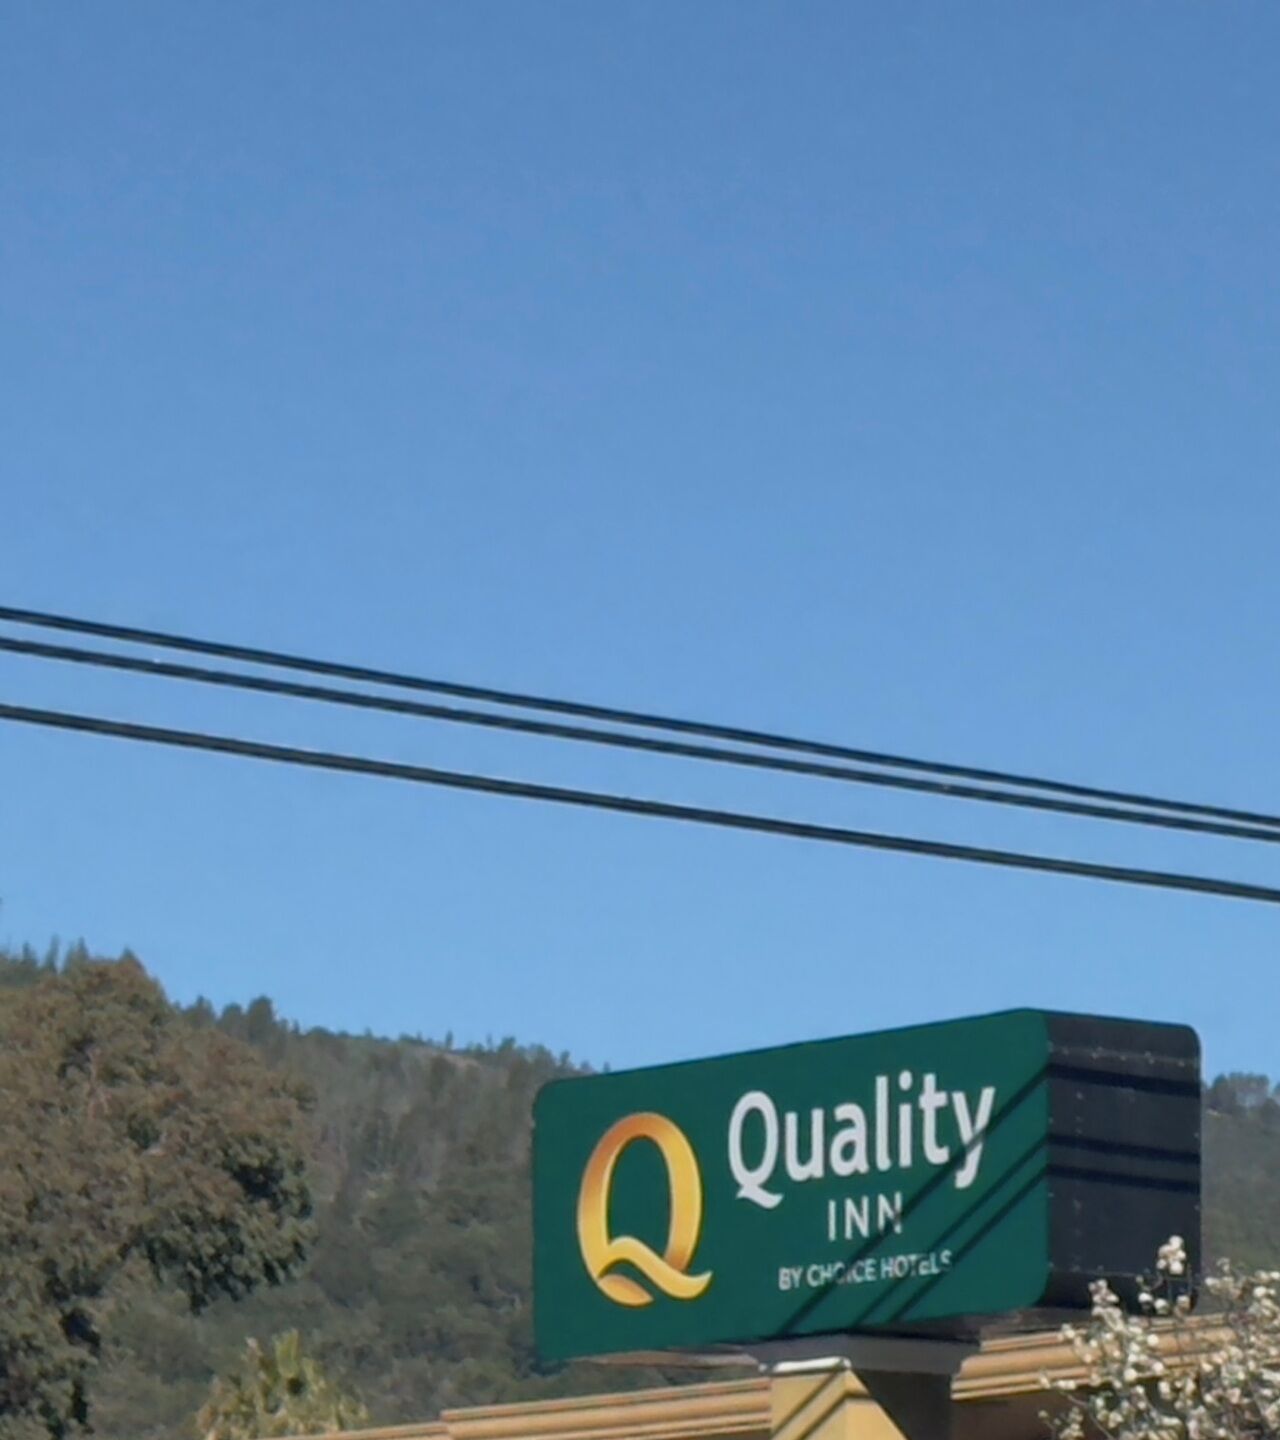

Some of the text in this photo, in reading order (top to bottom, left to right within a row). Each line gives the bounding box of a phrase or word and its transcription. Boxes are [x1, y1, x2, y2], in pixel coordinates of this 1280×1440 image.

[728, 1070, 996, 1209] Quality
[577, 1111, 713, 1309] Q
[828, 1191, 903, 1241] INN
[778, 1249, 953, 1291] BY CHOICE HOTELS
